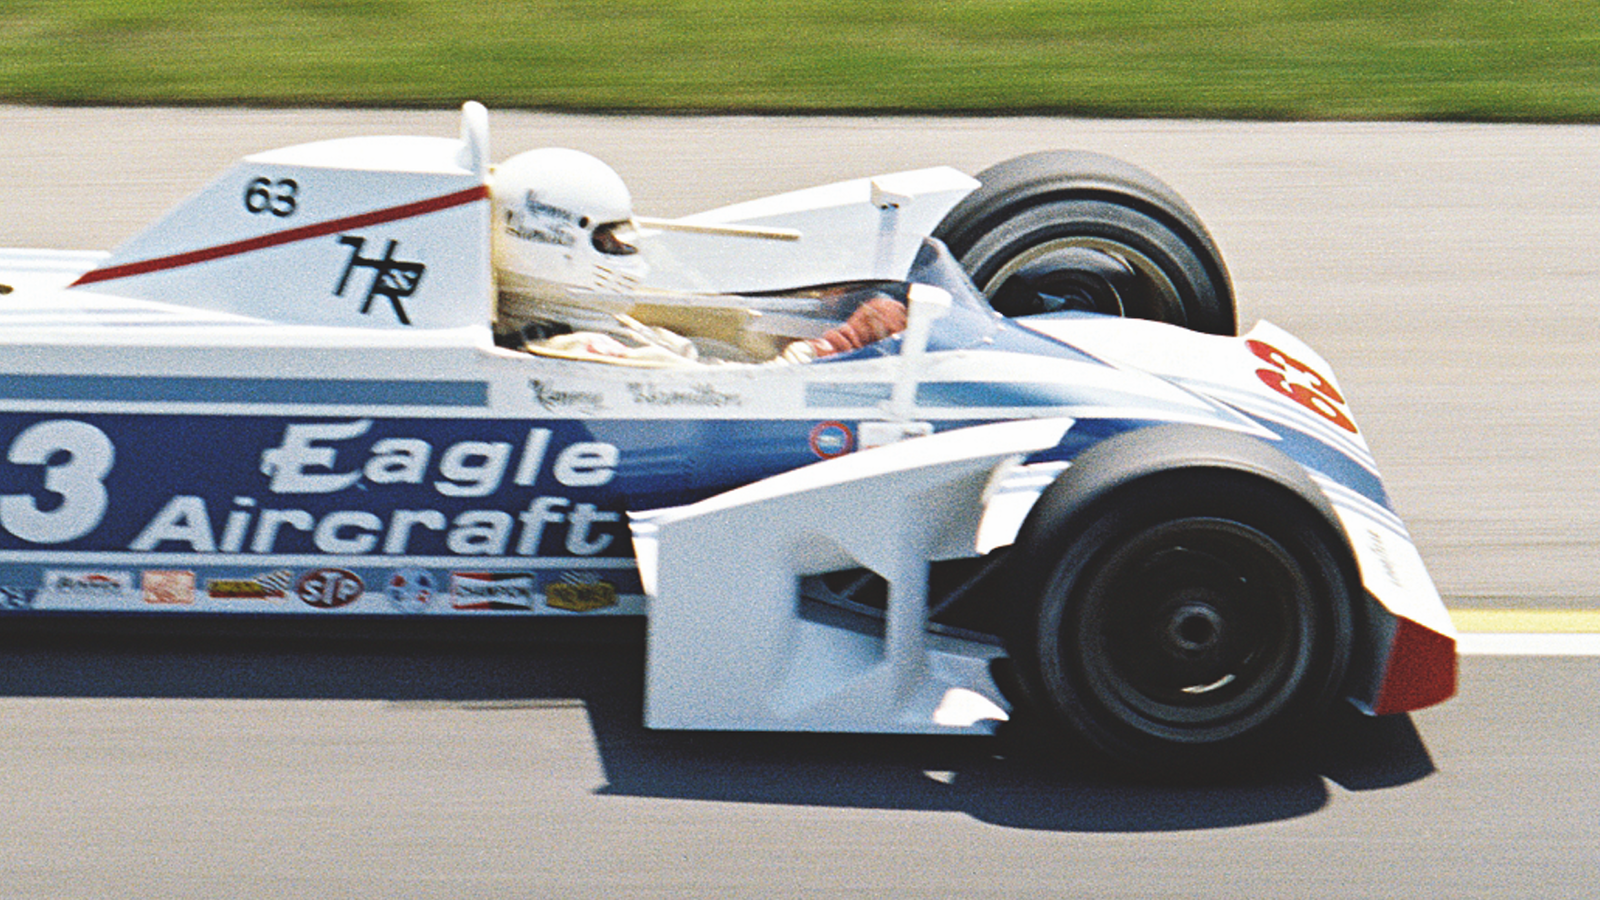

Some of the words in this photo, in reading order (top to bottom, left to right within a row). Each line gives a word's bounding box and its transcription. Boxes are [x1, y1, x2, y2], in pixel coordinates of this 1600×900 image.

[245, 177, 299, 217] 63
[261, 419, 620, 498] Eagle
[129, 496, 620, 556] Aircraft
[302, 576, 358, 604] STP
